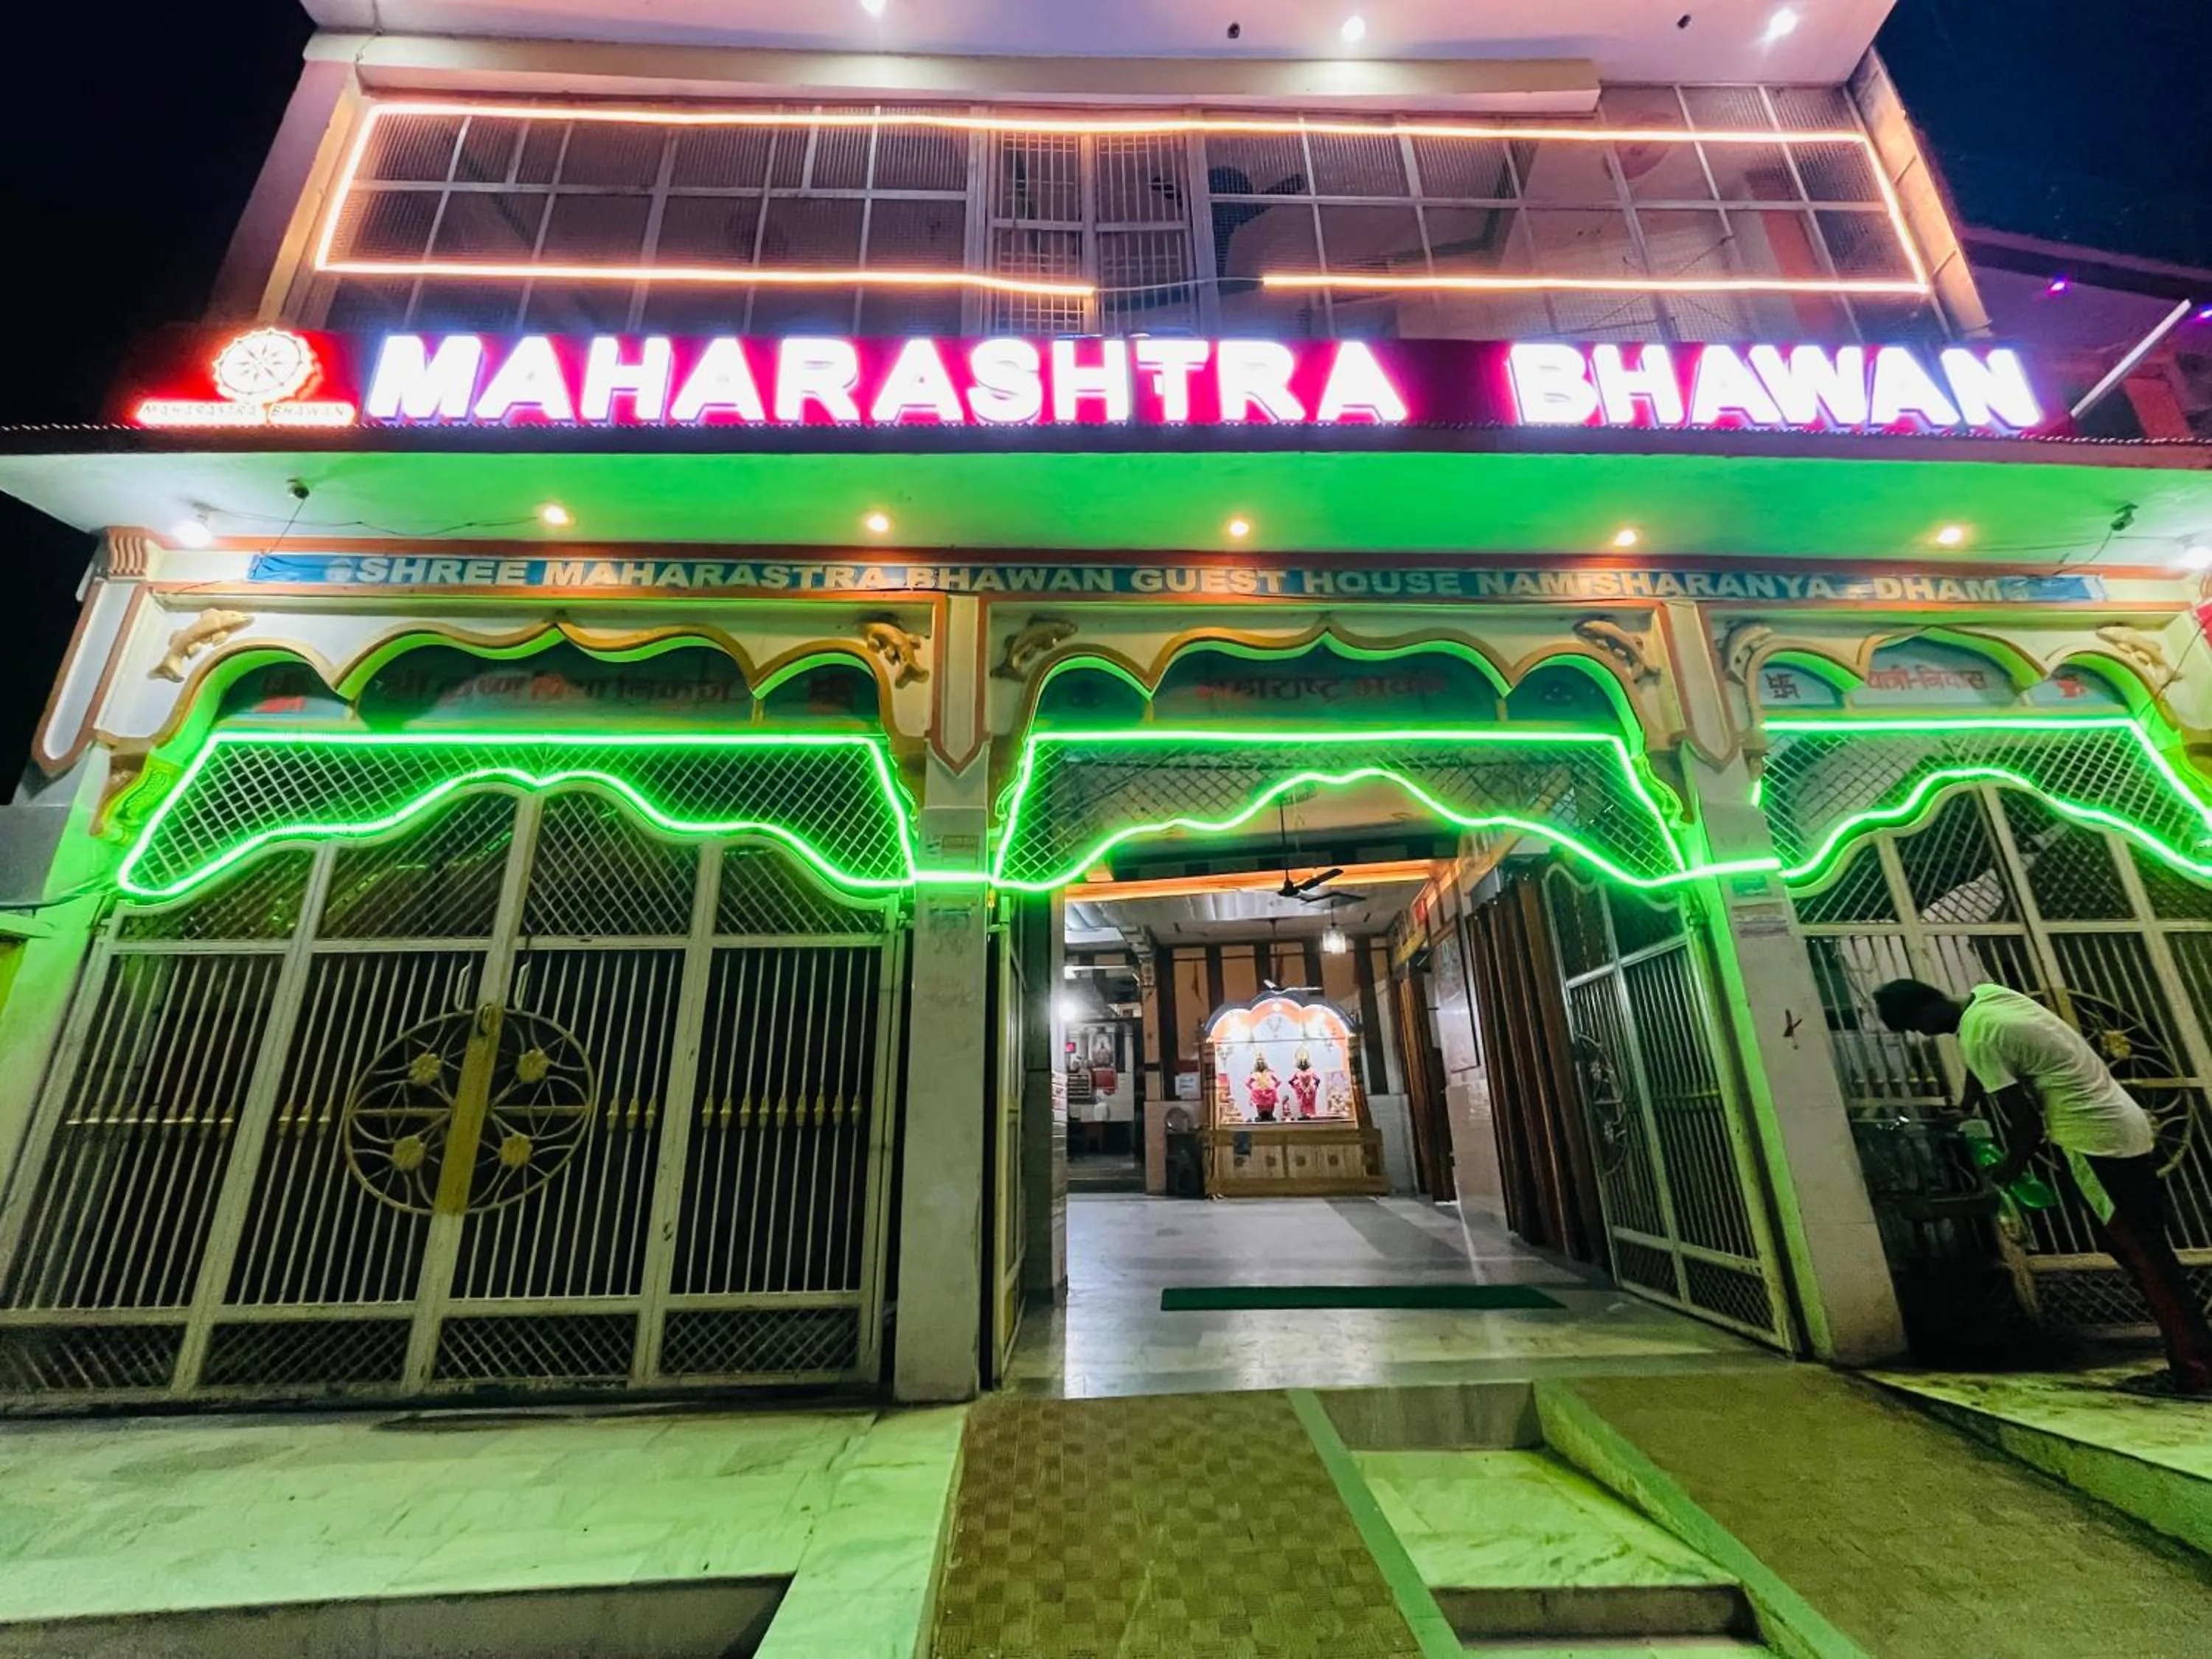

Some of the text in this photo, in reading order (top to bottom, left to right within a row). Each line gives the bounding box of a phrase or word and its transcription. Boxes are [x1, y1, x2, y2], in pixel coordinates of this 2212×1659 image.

[366, 335, 2042, 429] MAHARASHTRA BHAWAN
[356, 557, 526, 585] SHREE
[542, 563, 885, 590] MAHARASTRA
[906, 567, 1113, 592] BHAWAN
[1130, 568, 1287, 594] GUEST
[1304, 571, 1462, 595] HOUSE
[1872, 577, 2003, 602] DHAM
